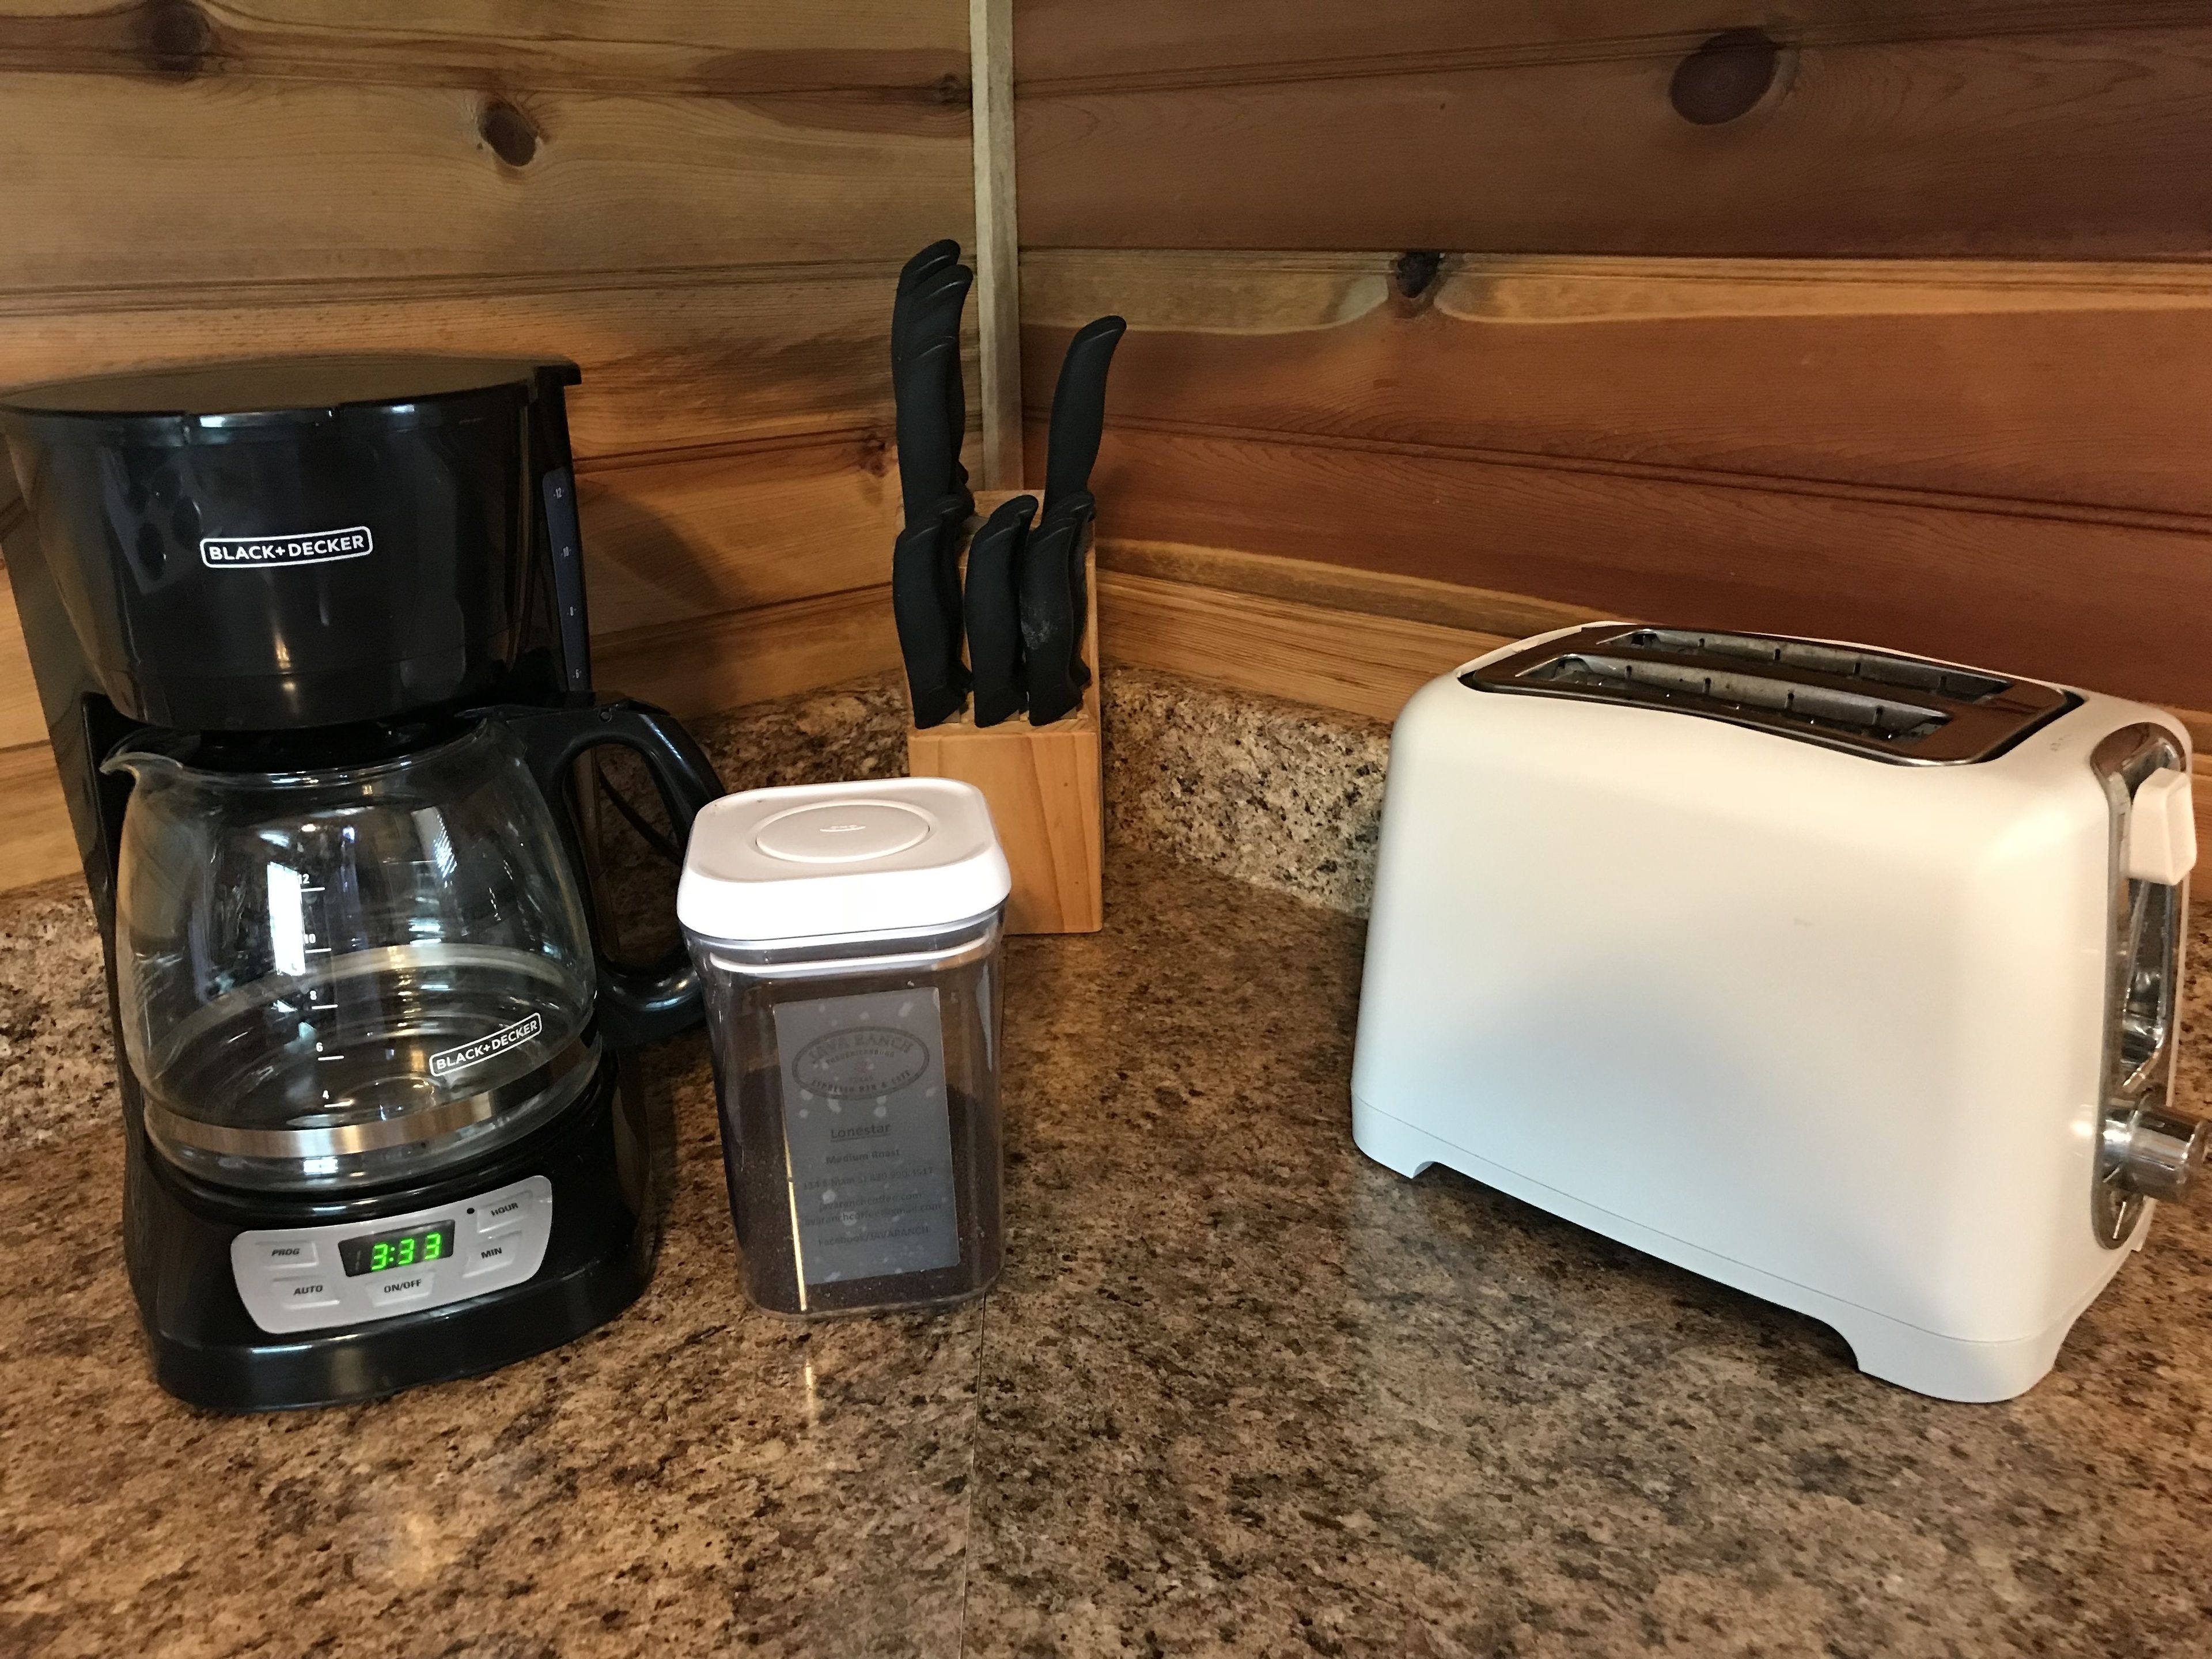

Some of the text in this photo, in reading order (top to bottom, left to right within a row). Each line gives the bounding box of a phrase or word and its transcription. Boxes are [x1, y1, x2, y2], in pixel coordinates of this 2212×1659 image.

[209, 535, 365, 560] BLACK+DECKER
[298, 873, 310, 884] 12
[304, 933, 316, 944] 10
[310, 990, 317, 1001] 8
[316, 1041, 323, 1052] 6
[436, 1020, 538, 1070] BLACK+DECKER
[831, 1123, 891, 1139] Lonestar
[825, 1149, 900, 1165] Medium Roast
[490, 1202, 519, 1217] HOUR
[271, 1248, 300, 1257] PROG
[371, 1232, 441, 1271] 3:33
[480, 1247, 503, 1259] MIN
[293, 1285, 323, 1296] AUTO
[384, 1279, 422, 1294] ON/OFF
